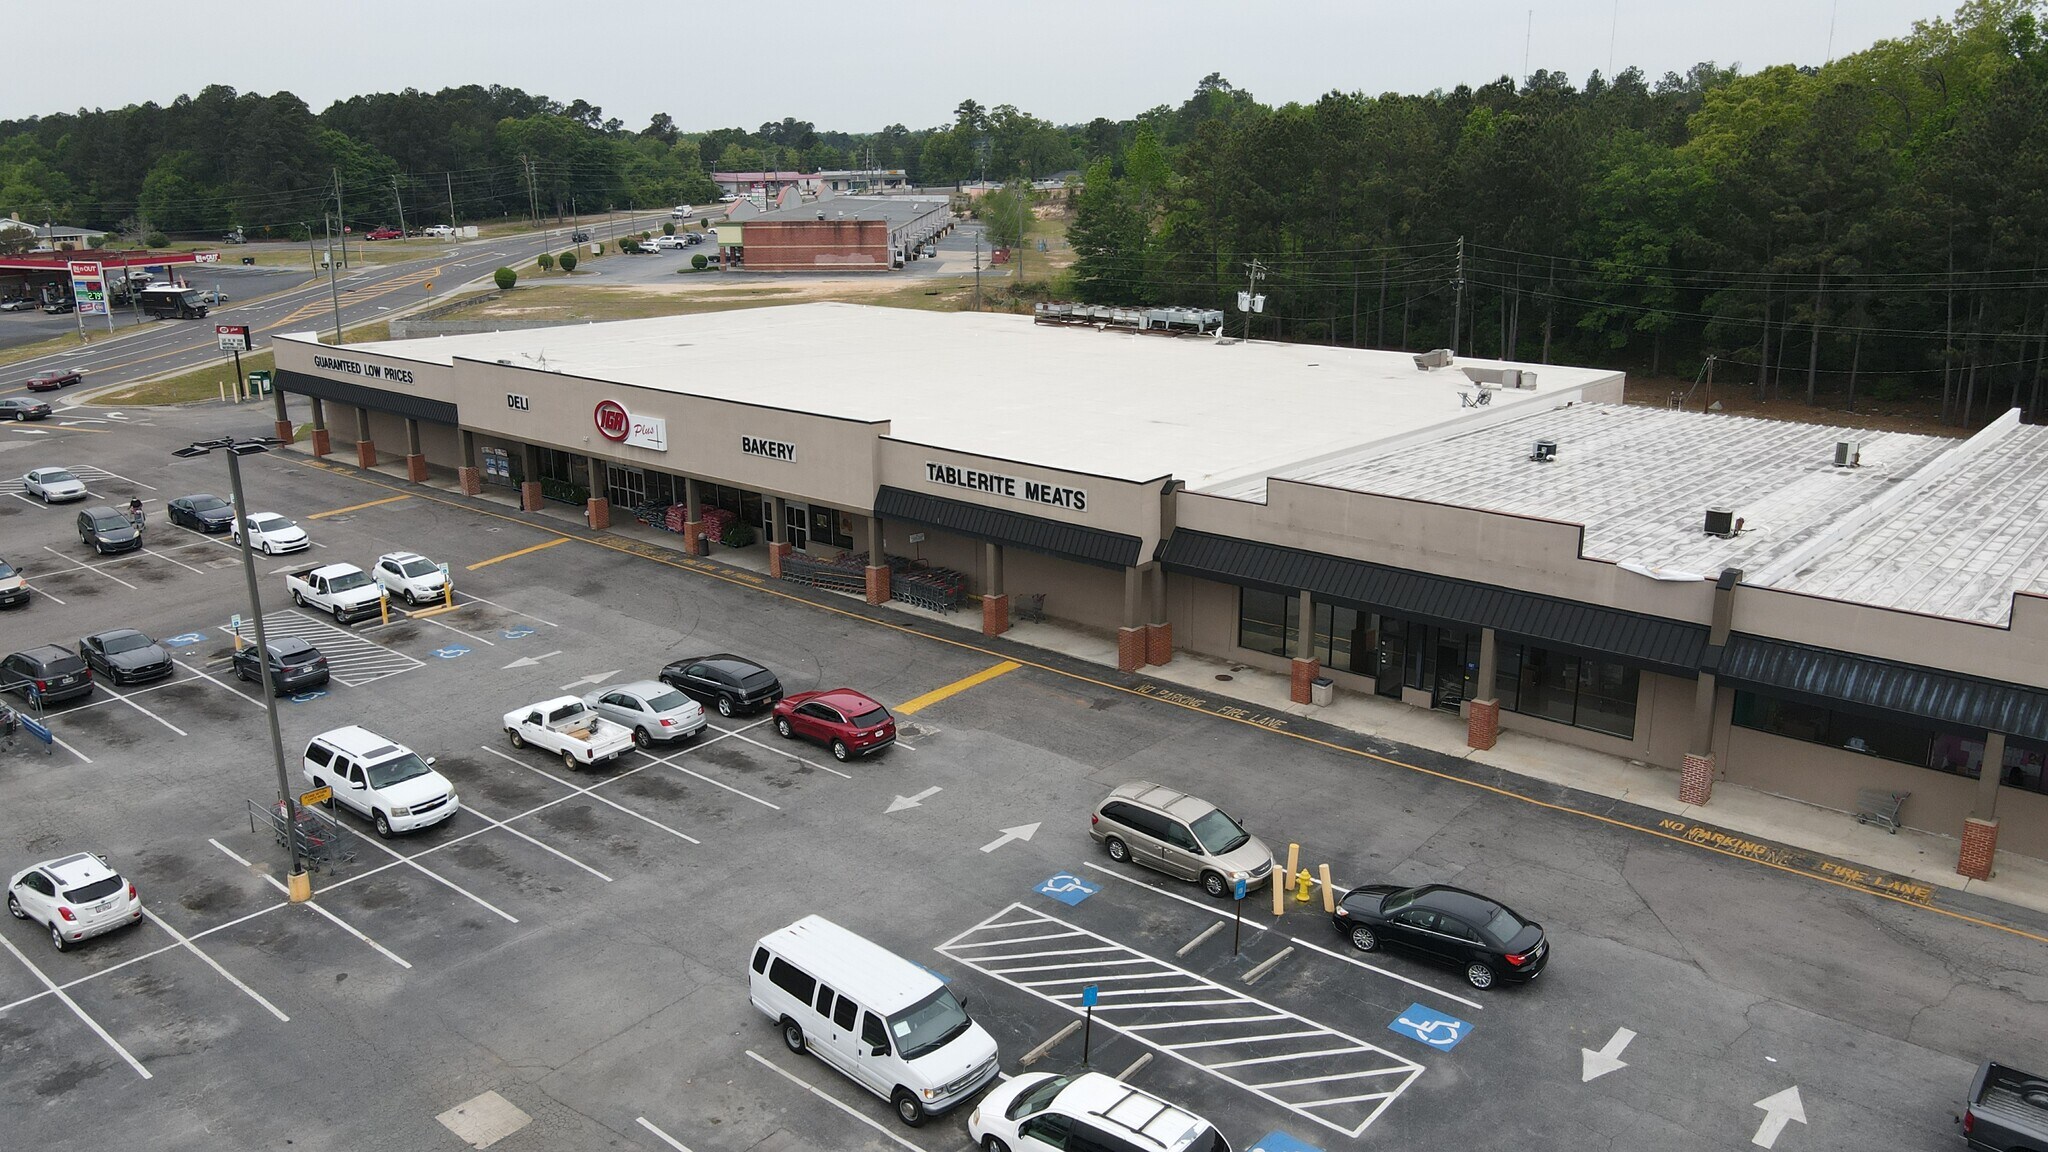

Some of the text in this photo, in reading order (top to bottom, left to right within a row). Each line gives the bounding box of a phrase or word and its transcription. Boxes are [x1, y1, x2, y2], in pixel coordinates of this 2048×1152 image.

[314, 355, 414, 383] GUARANTEED LOW PRICES
[507, 394, 529, 410] DELI
[600, 409, 655, 437] IGA Plus
[742, 436, 795, 461] BAKERY
[927, 463, 1086, 510] TABLERITE MEATS
[1134, 683, 1288, 729] NO PARKING FIRE LANE
[1659, 819, 1686, 831] NO
[1689, 826, 1768, 854] PARKING
[1821, 861, 1869, 881] FIRE
[1873, 876, 1933, 900] LANE
